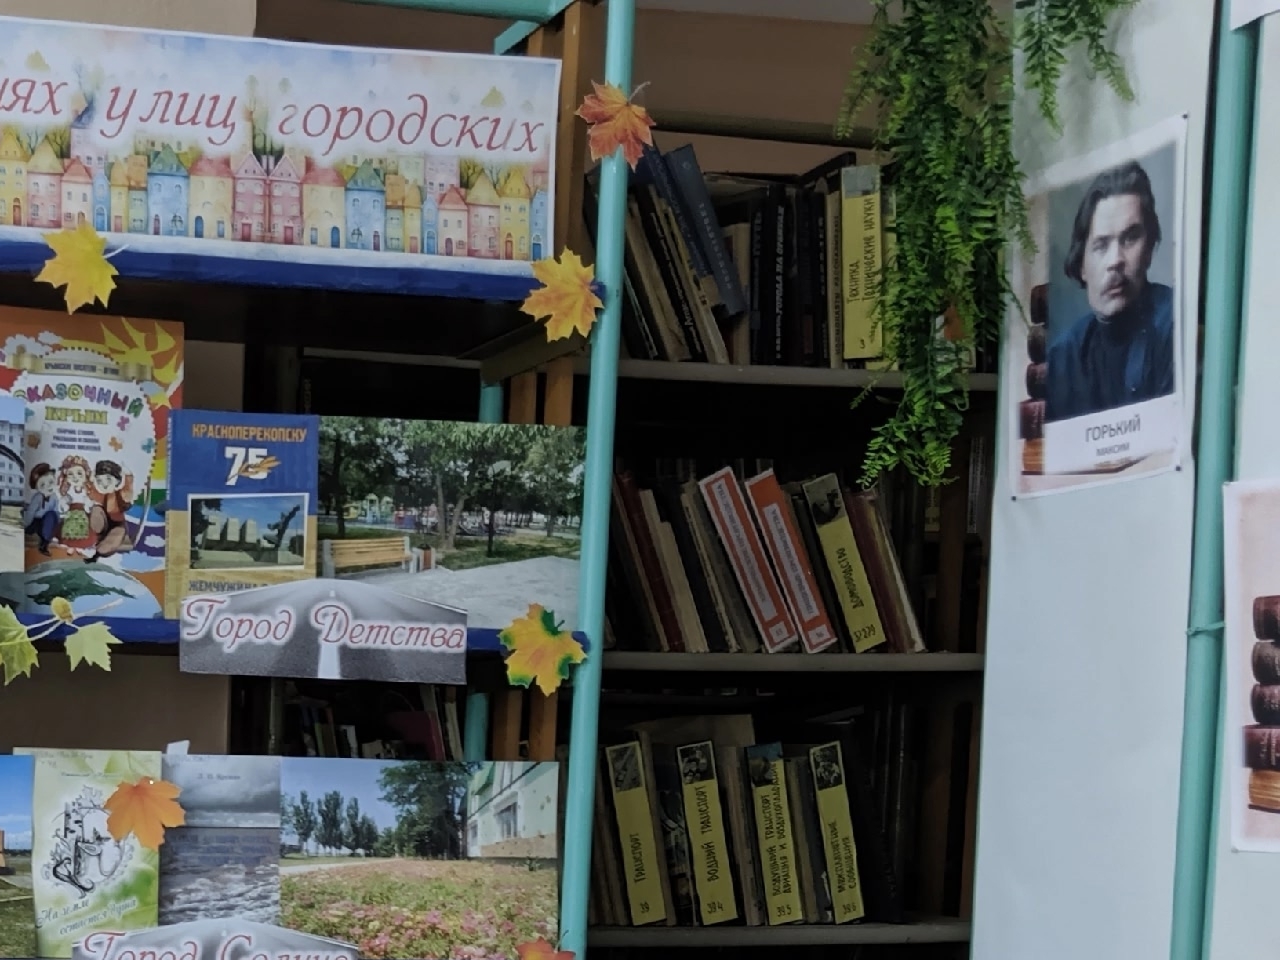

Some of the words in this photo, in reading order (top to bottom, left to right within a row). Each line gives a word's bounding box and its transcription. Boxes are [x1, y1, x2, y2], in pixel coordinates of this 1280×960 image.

[100, 85, 238, 146] улиц
[277, 93, 546, 156] городских
[192, 423, 308, 443] КРАСНОПЕРЕКОПСКУ
[1085, 414, 1141, 443] ГОРЬКИЙ
[224, 446, 270, 486] 75
[185, 598, 293, 650] Город
[314, 603, 465, 649] Детства
